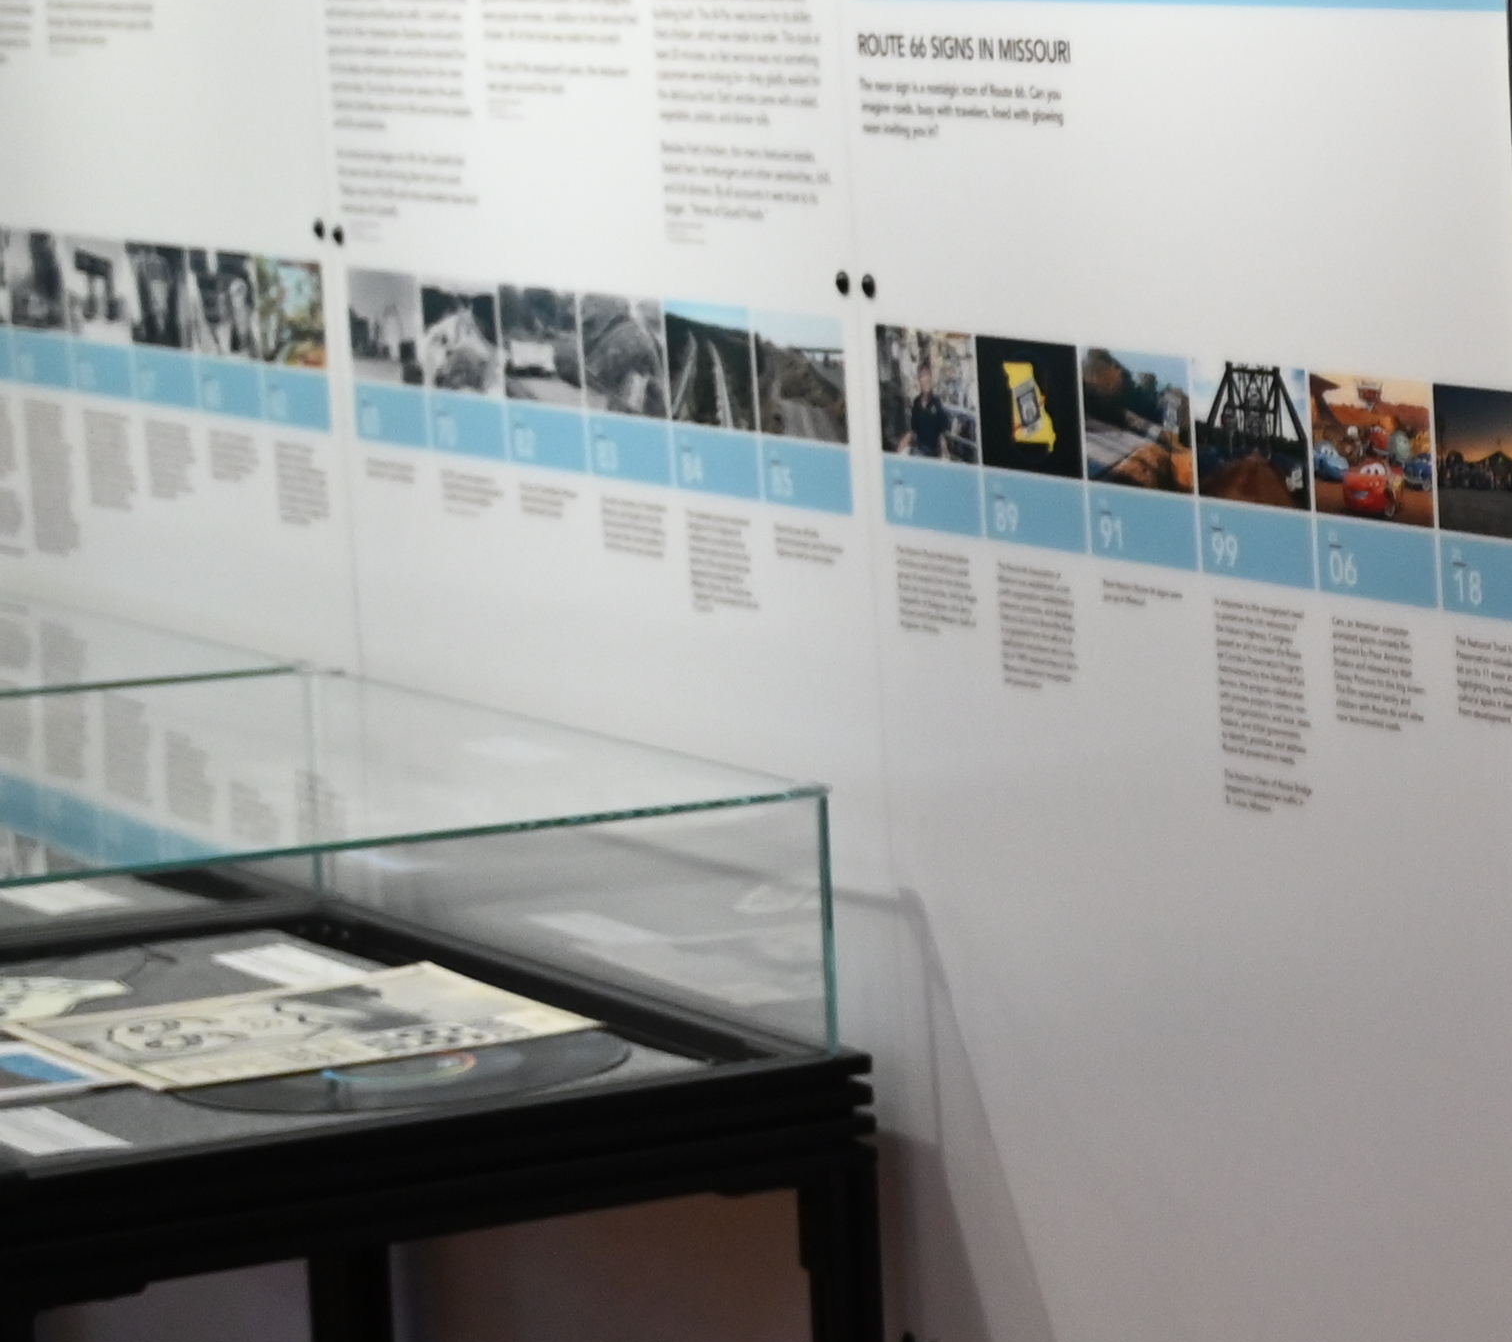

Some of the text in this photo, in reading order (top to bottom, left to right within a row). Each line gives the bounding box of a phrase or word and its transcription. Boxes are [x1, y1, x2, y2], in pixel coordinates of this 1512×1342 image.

[858, 33, 1072, 63] ROUTE 66 SIGNS IN MISSOURI
[1211, 533, 1239, 567] 99
[1330, 553, 1358, 587] 06
[1454, 567, 1483, 606] 18
